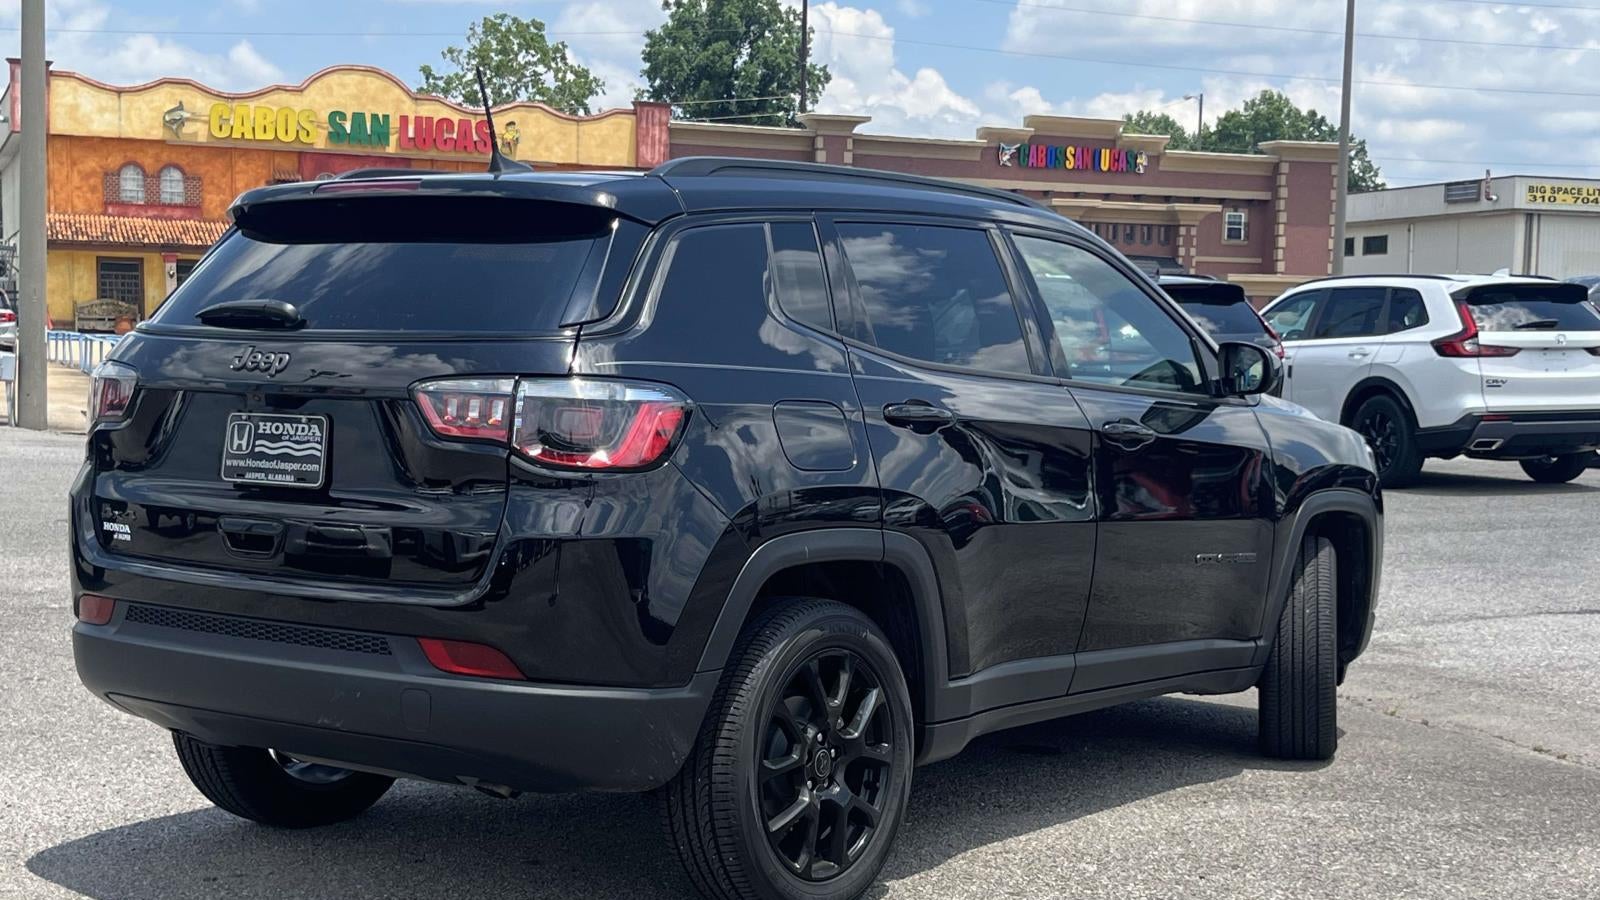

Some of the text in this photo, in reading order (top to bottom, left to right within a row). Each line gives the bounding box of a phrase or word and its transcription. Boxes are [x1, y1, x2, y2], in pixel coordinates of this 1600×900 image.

[209, 103, 493, 154] CABOS SAN LUCAS
[1019, 143, 1136, 172] CABOS SAN LUCAS
[1528, 185, 1546, 194] BIG
[1550, 186, 1583, 195] SPACE
[1528, 194, 1557, 203] 310
[1571, 196, 1599, 204] 704
[230, 344, 290, 377] Jeep
[257, 421, 322, 436] HONDA
[226, 458, 320, 472] www.HondaofJasper.com
[103, 521, 131, 533] HONDA
